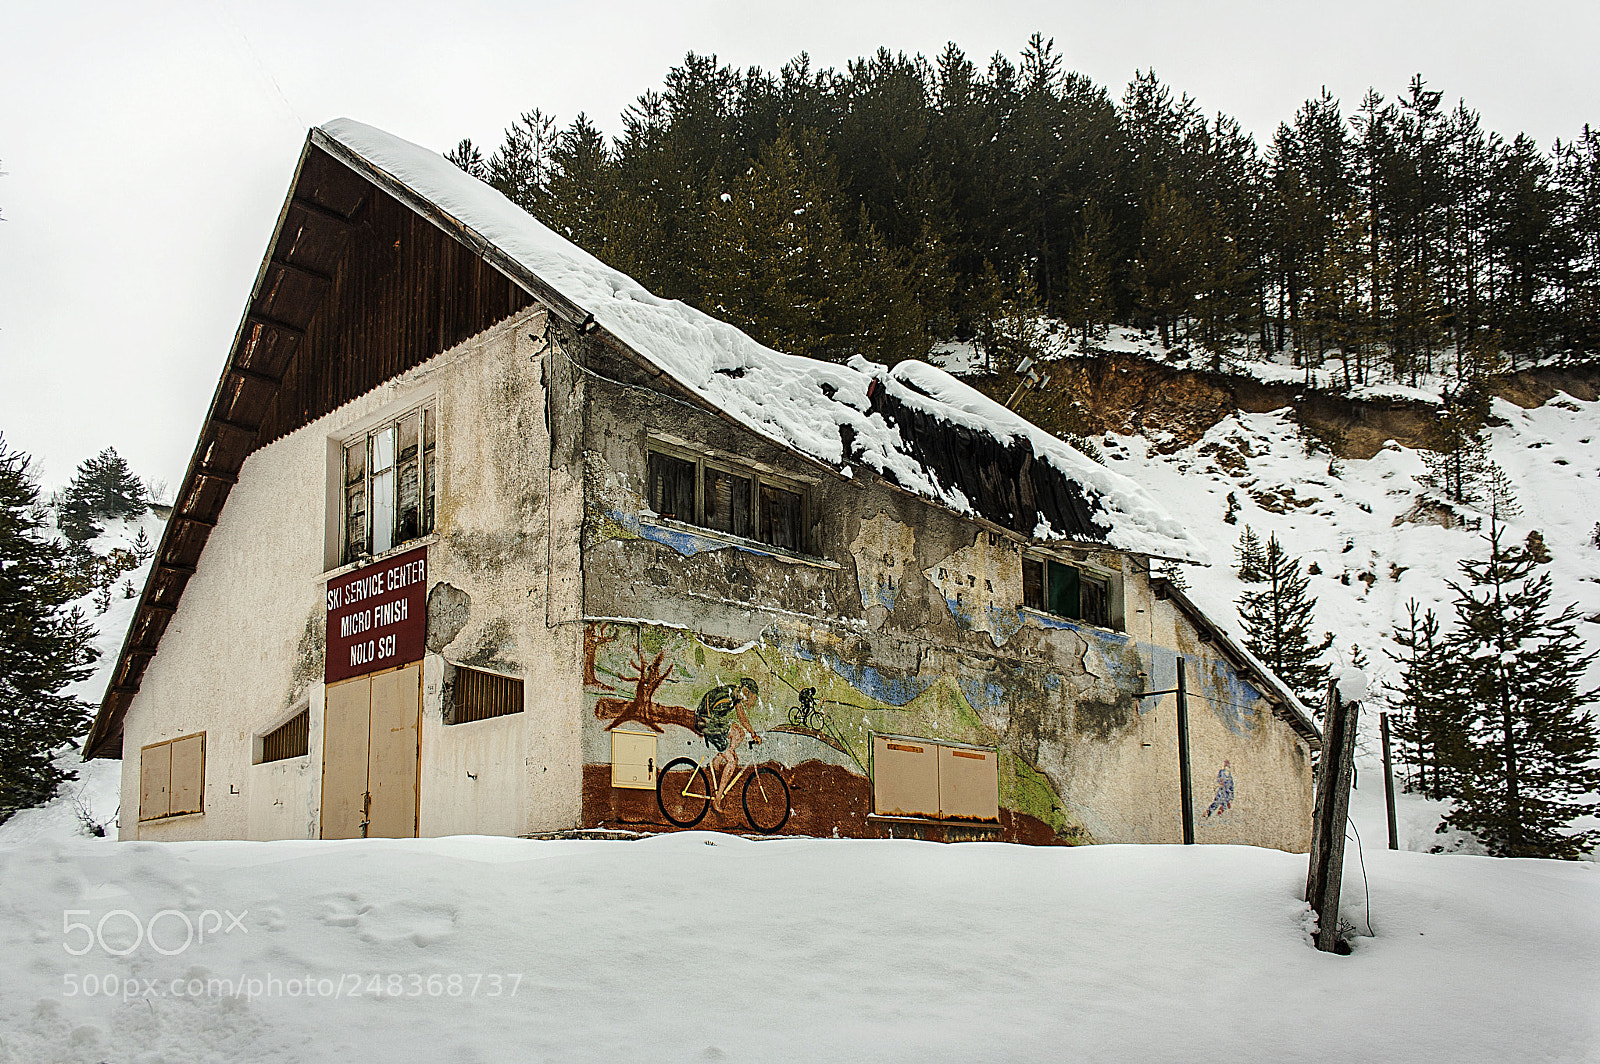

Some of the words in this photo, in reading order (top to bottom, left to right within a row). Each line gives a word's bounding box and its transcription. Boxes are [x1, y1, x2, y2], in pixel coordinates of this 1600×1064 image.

[327, 587, 342, 611] SKI
[345, 572, 384, 605] SERVICE
[387, 559, 425, 591] CENTER
[340, 609, 371, 638] MICRO
[374, 597, 408, 628] FINISH
[350, 640, 375, 667] NOLO
[378, 634, 396, 659] SCI
